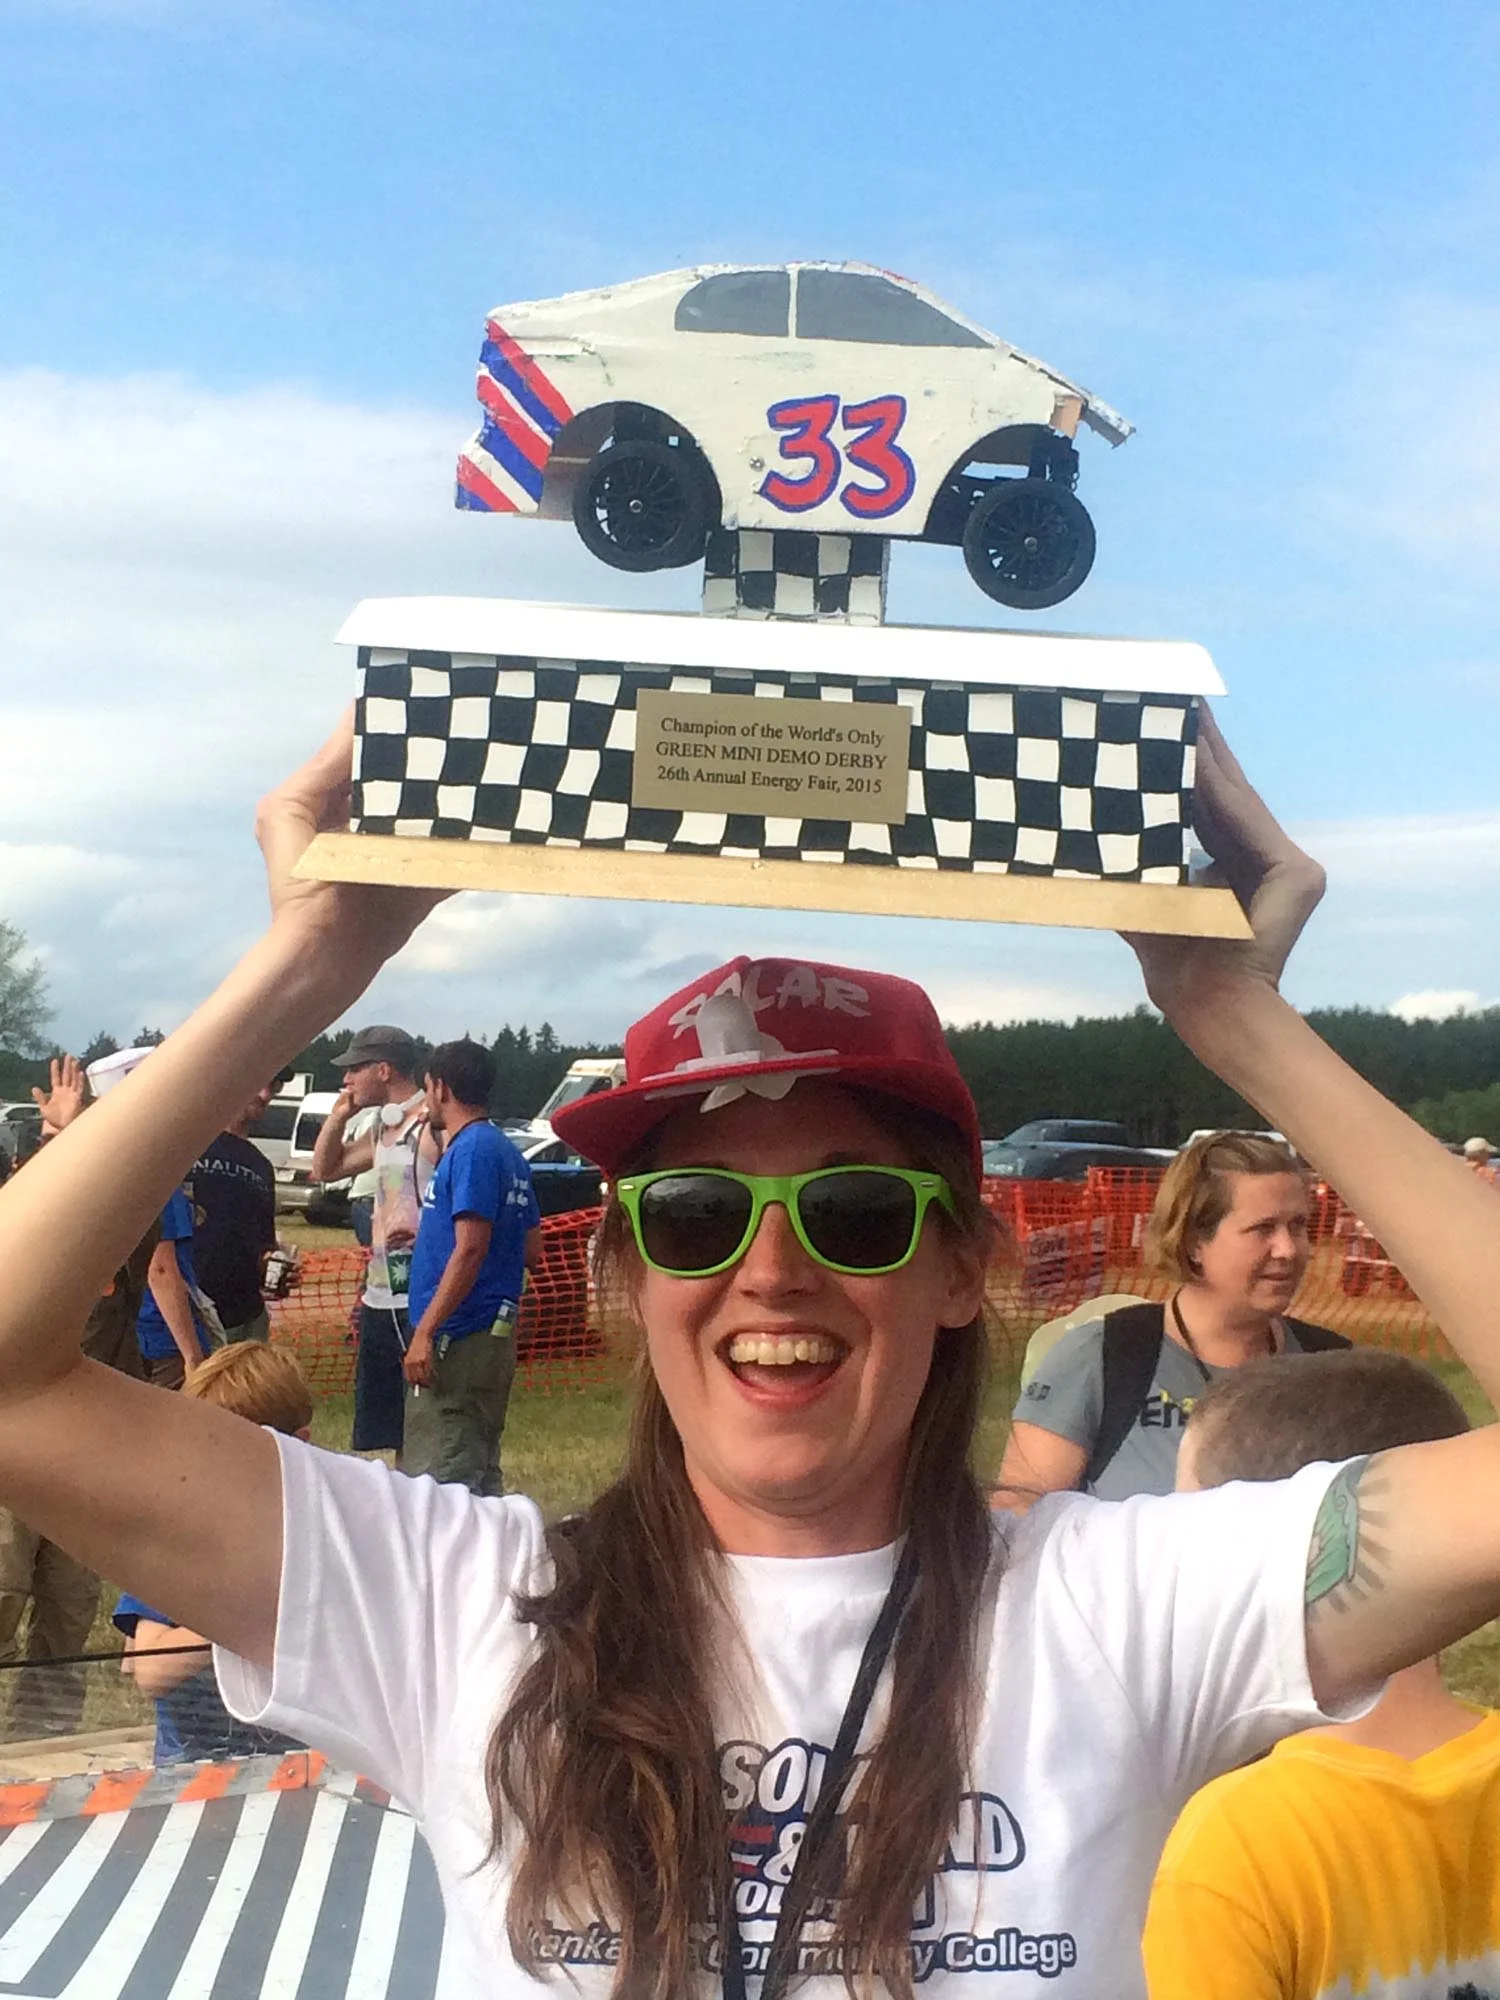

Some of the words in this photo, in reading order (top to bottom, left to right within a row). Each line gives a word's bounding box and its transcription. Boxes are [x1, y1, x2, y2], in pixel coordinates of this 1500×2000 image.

[759, 393, 917, 520] 33
[660, 717, 738, 739] Champion
[740, 722, 759, 738] of
[760, 723, 784, 740] the
[787, 725, 844, 743] World's
[847, 729, 885, 748] Only
[656, 741, 717, 760] GREEN
[720, 746, 763, 763] MINI
[766, 748, 821, 766] DEMO
[824, 751, 888, 770] DERBY
[657, 765, 690, 783] 26th
[692, 768, 747, 786] Annual
[750, 772, 804, 792] Energy
[807, 775, 842, 794] Fair,
[845, 777, 883, 794] 2015
[944, 1928, 1077, 1978] College
